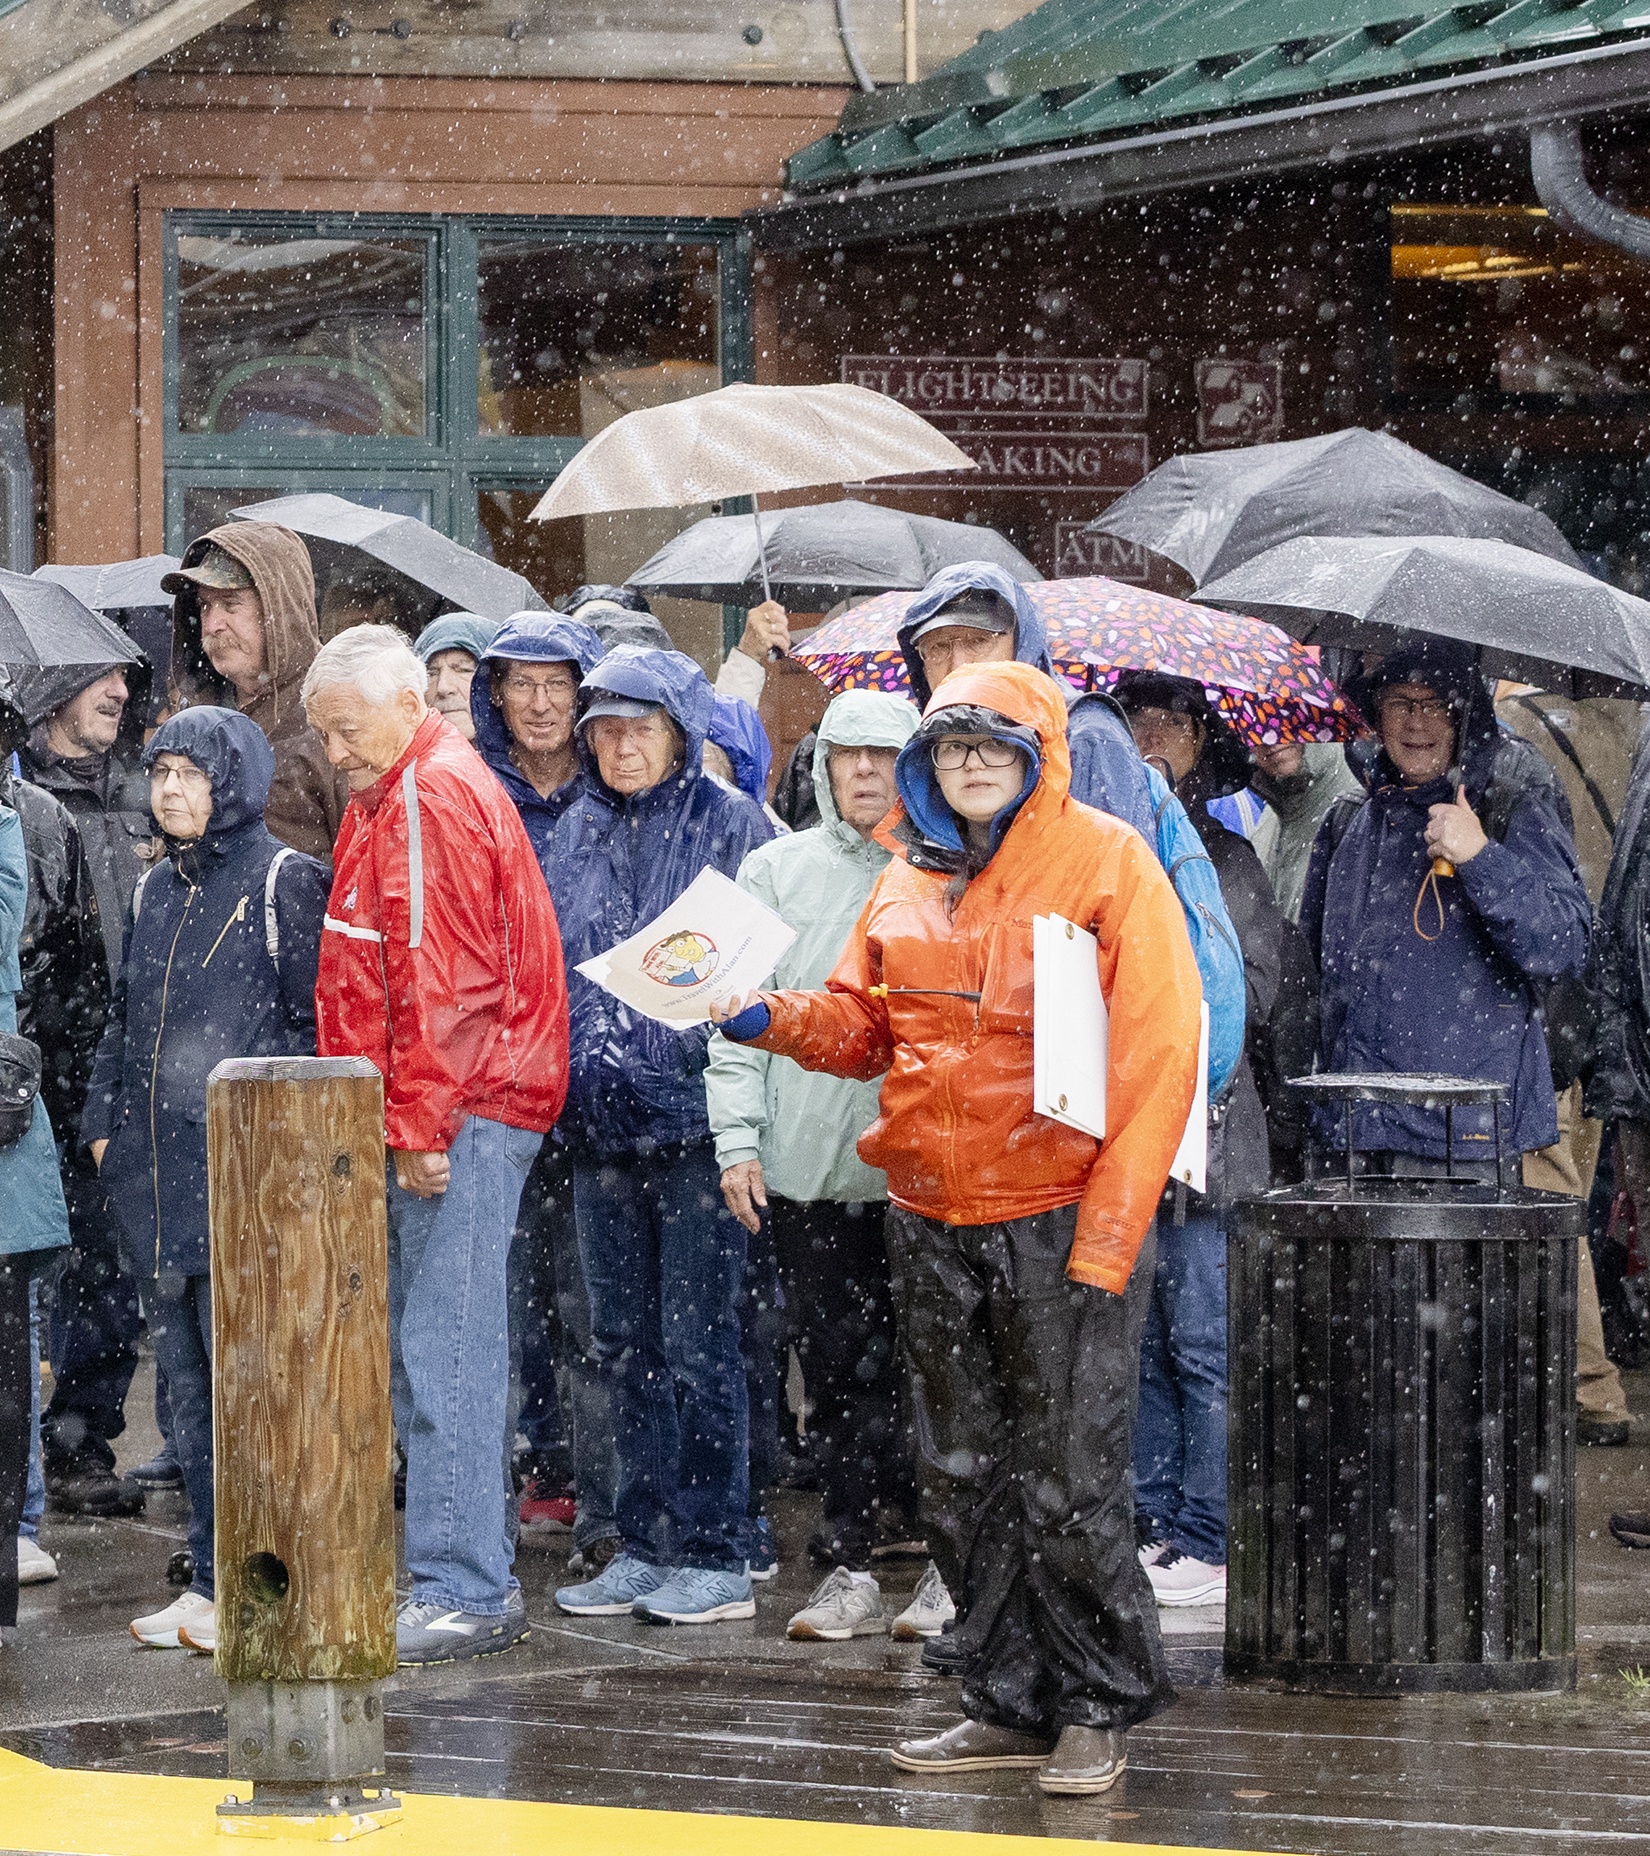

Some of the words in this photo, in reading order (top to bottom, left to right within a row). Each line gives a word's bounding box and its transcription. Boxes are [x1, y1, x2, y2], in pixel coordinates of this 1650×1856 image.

[856, 369, 1138, 402] FLIGHTSEEING
[954, 446, 1102, 476] AKING
[1061, 533, 1144, 565] ATM
[662, 936, 753, 1007] www.TravelWithAlan.com
